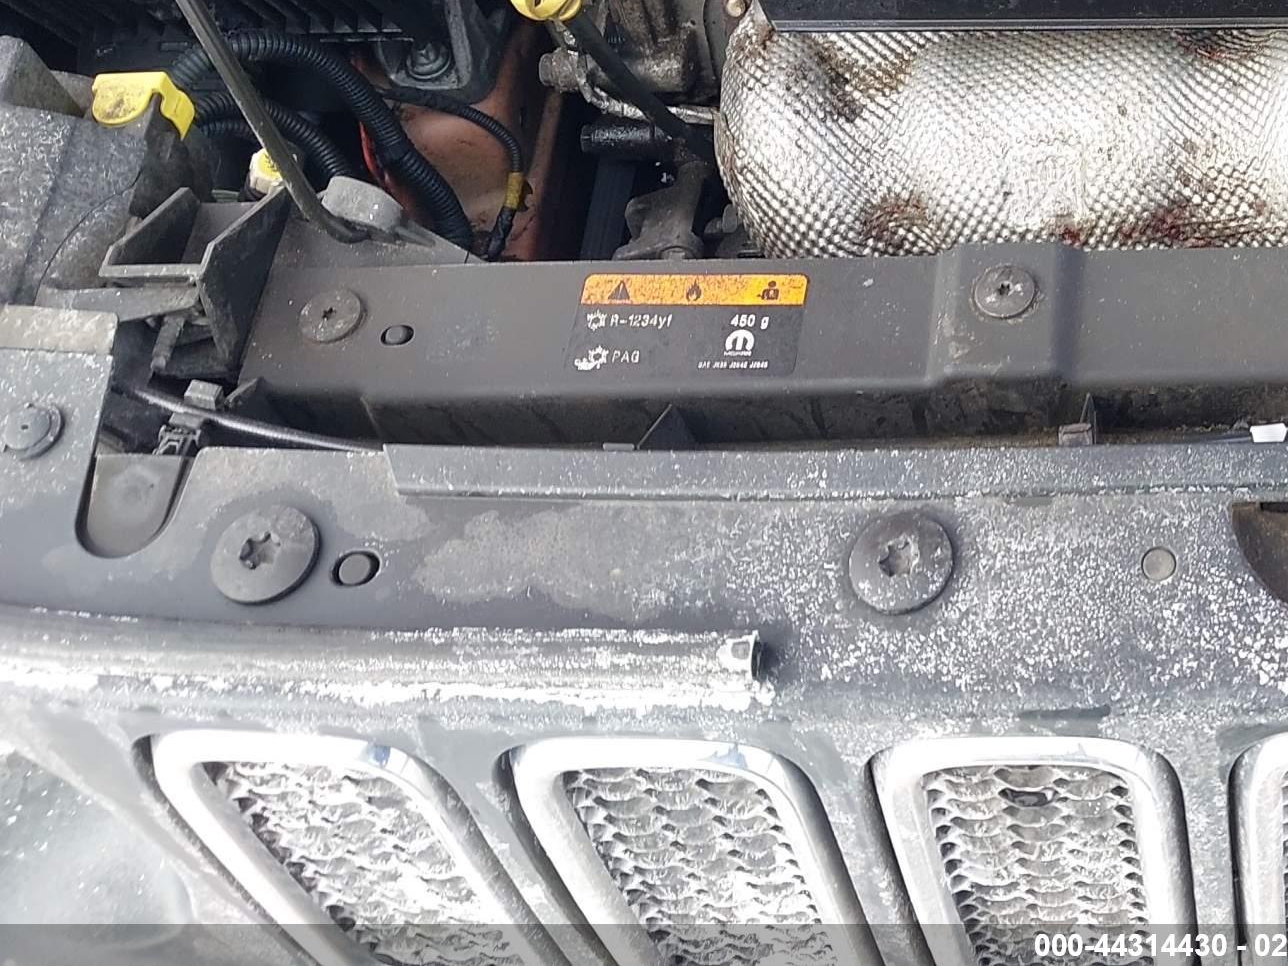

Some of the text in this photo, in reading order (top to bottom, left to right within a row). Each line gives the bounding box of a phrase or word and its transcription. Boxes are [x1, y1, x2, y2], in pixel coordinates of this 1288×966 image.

[609, 313, 673, 330] R-1234yf
[760, 316, 770, 330] g
[611, 349, 640, 363] PAG
